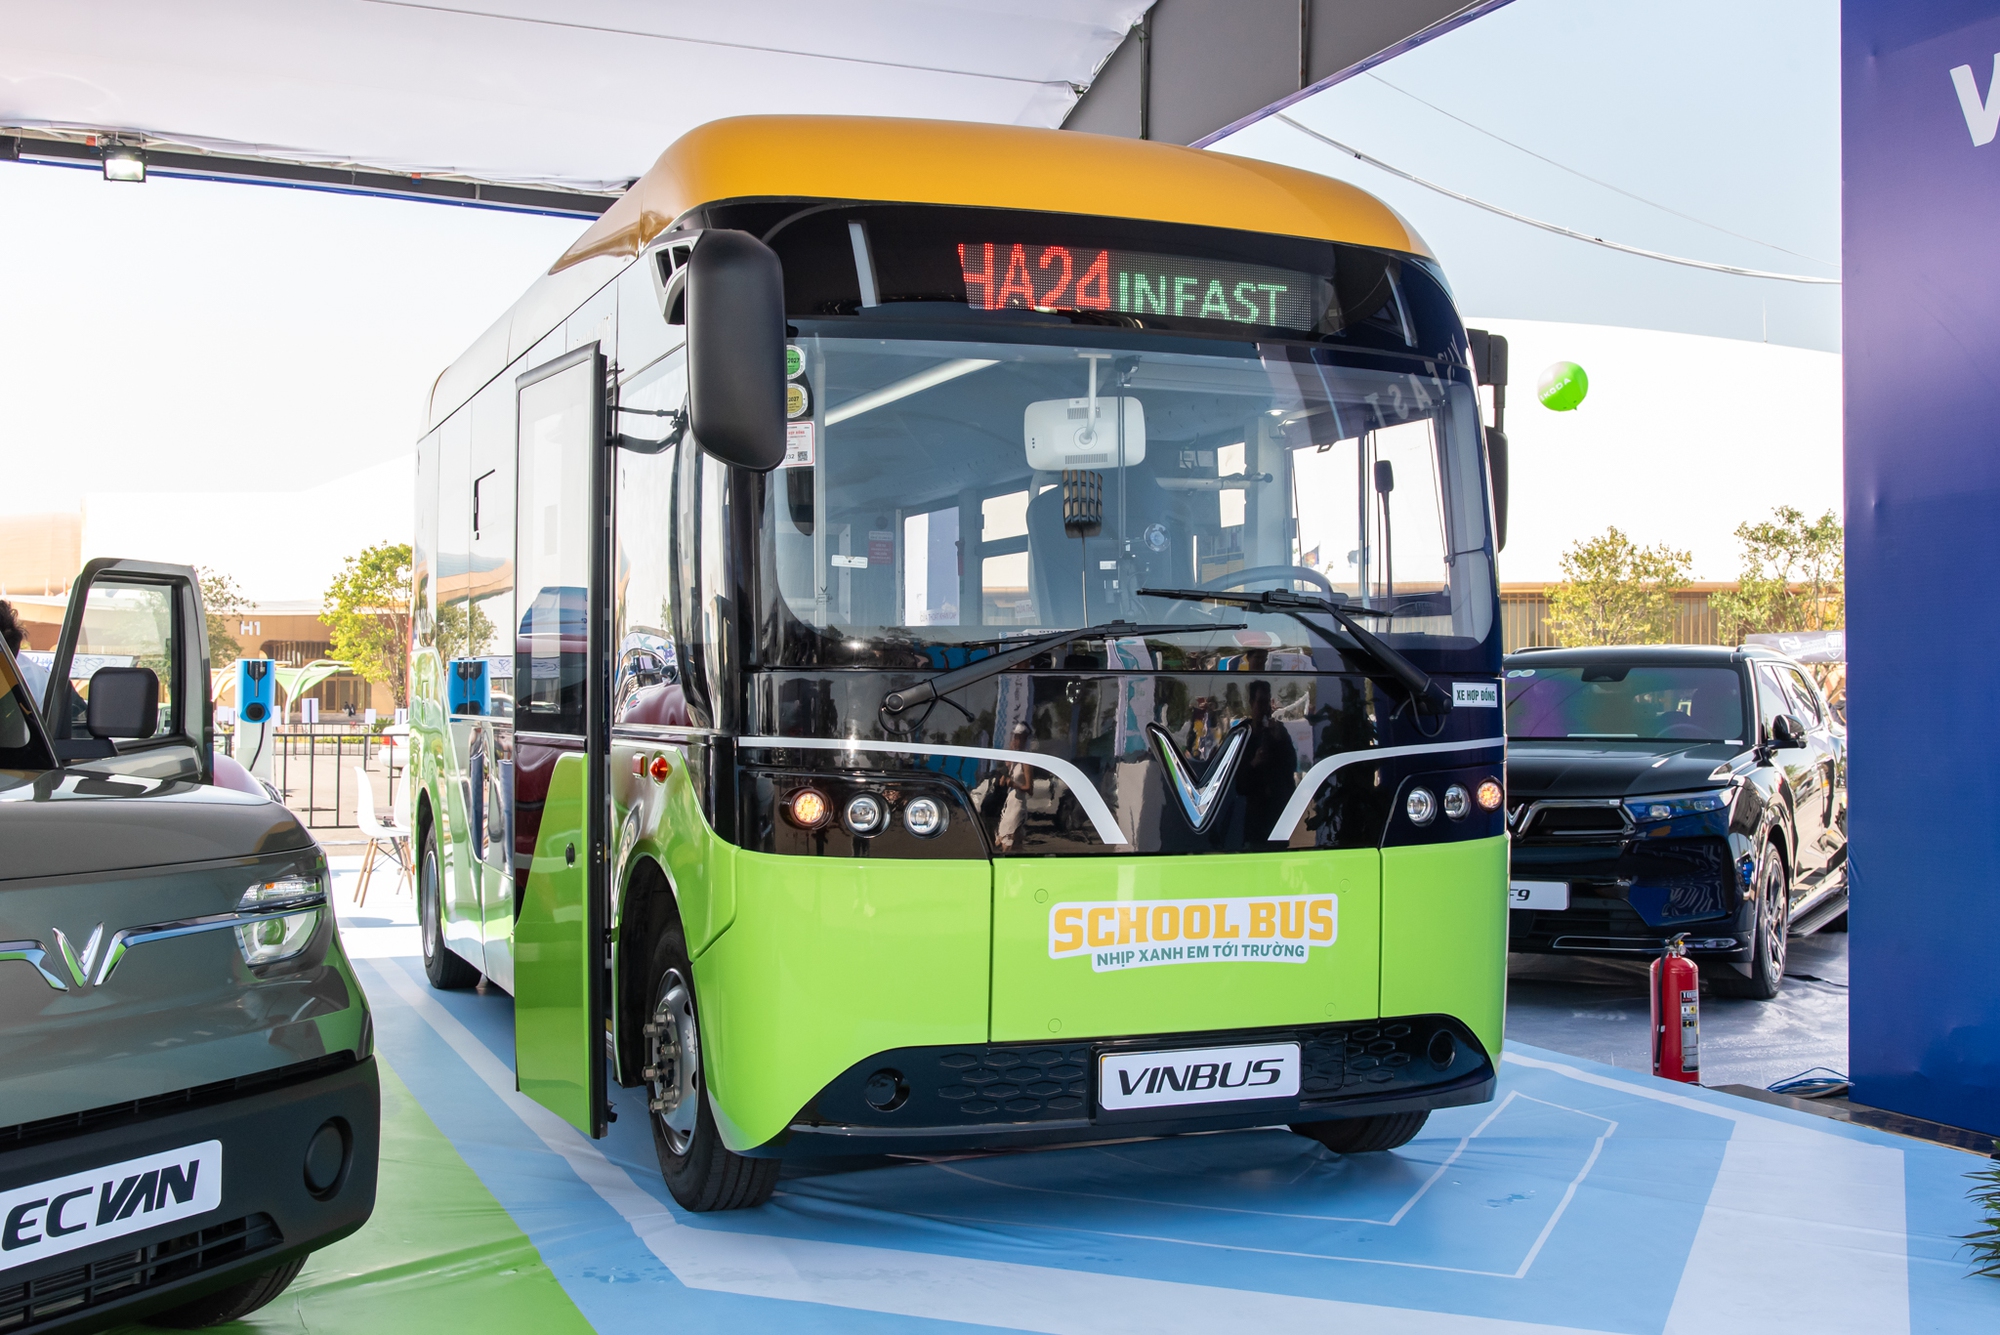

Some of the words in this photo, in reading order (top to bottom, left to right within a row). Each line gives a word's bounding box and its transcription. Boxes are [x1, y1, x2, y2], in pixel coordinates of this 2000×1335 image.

[1118, 271, 1288, 327] INFAST
[240, 621, 261, 636] H1
[1456, 690, 1465, 701] XE
[1053, 904, 1240, 953] SCHOOL
[1247, 899, 1333, 941] BUS
[1096, 951, 1135, 968] NHỊP
[1138, 947, 1183, 962] XANH
[1187, 946, 1209, 959] EM
[1213, 941, 1239, 958] TỚI
[1242, 941, 1305, 958] TRƯỜNG
[1118, 1058, 1285, 1096] VINBUS
